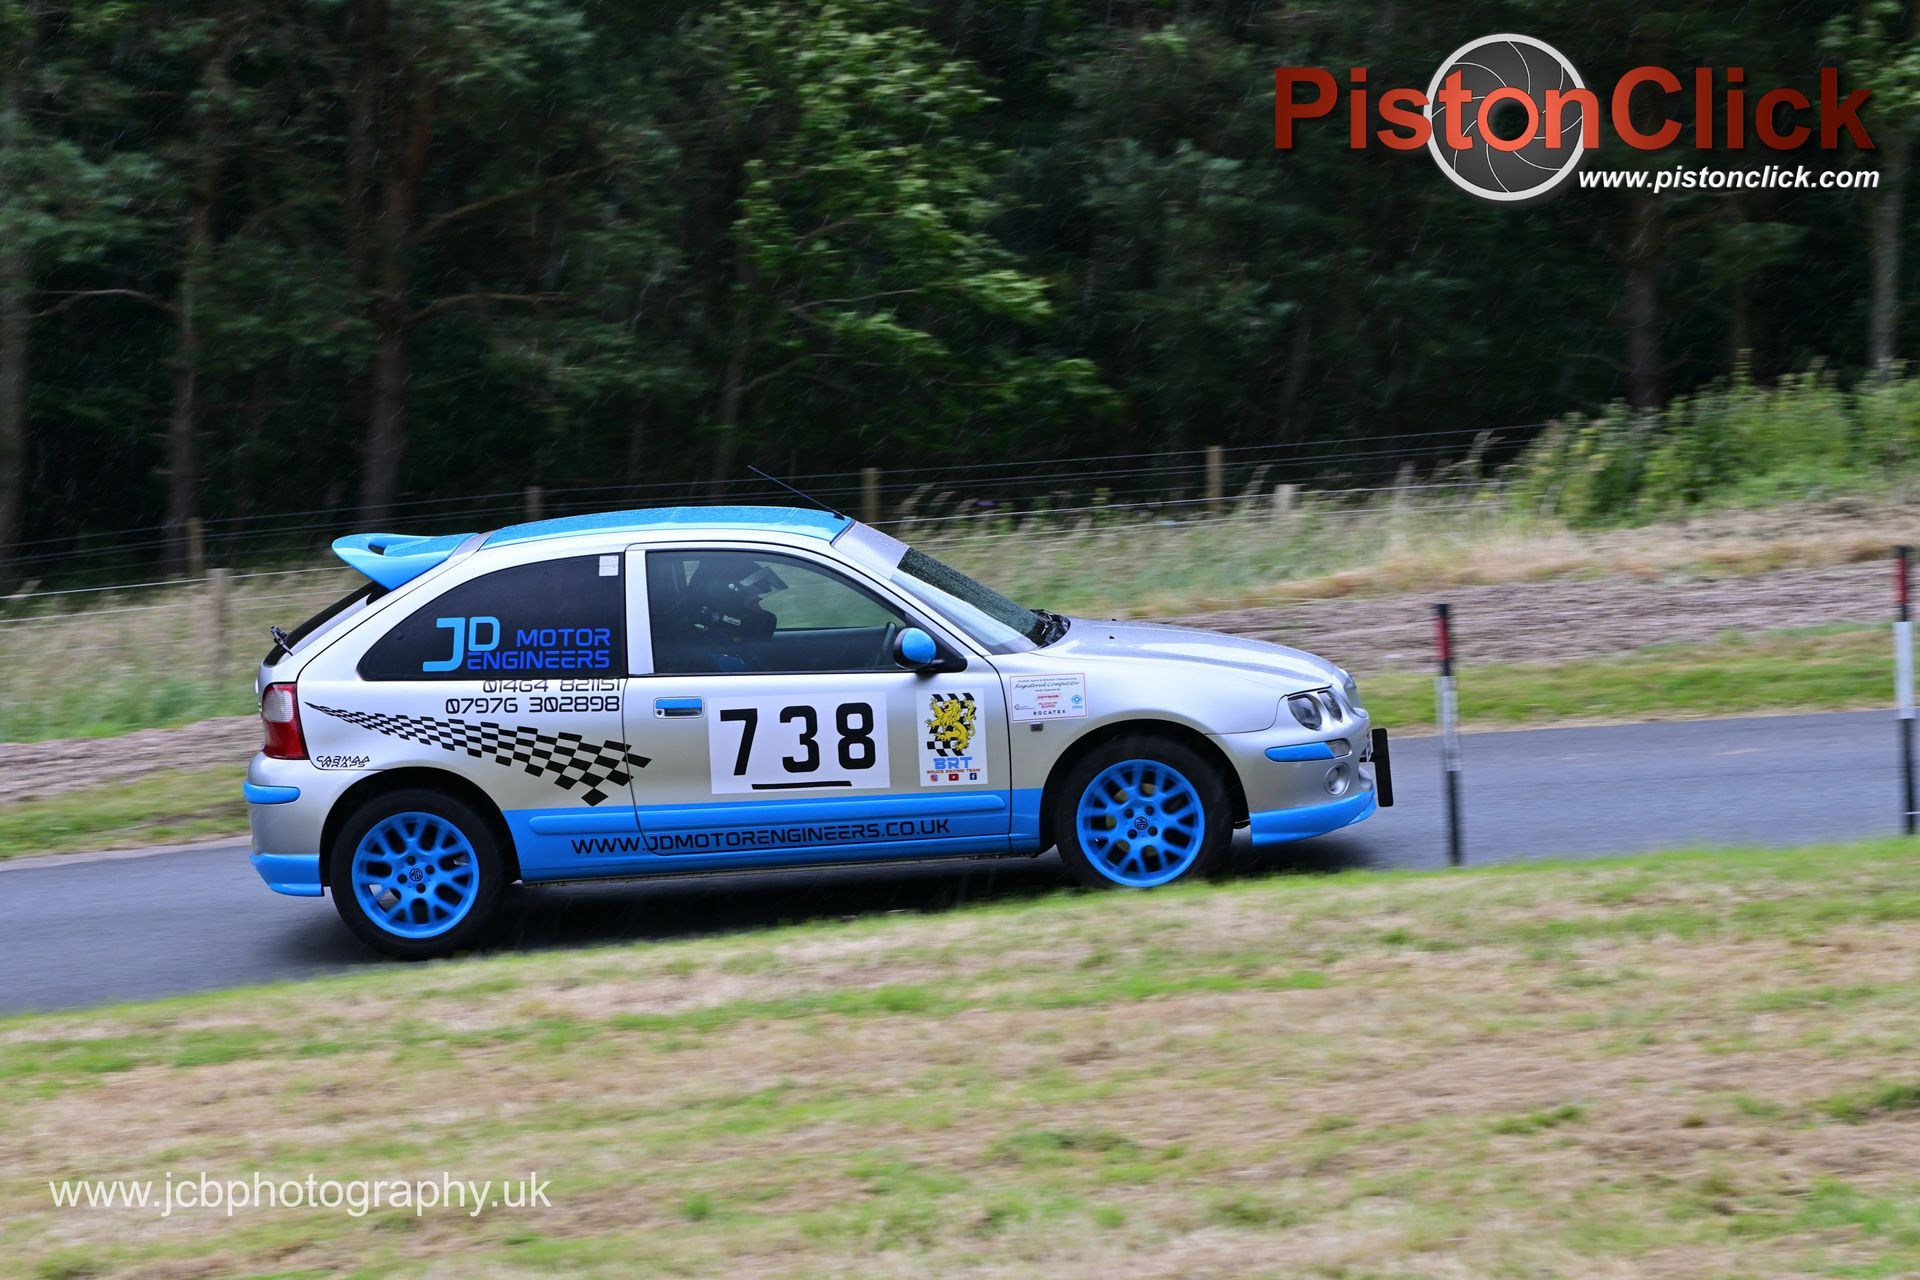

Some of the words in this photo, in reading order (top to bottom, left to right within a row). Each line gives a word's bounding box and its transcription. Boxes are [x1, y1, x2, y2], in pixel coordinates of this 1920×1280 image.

[423, 616, 500, 672] JD
[516, 628, 611, 648] MOTOR
[466, 650, 610, 670] ENGINEERS
[445, 697, 518, 714] 07976
[529, 696, 620, 713] 302898
[719, 702, 876, 776] 738
[933, 756, 973, 769] BRT
[571, 819, 950, 854] WWW.JDMOTORENGINEERS.CO.UK
